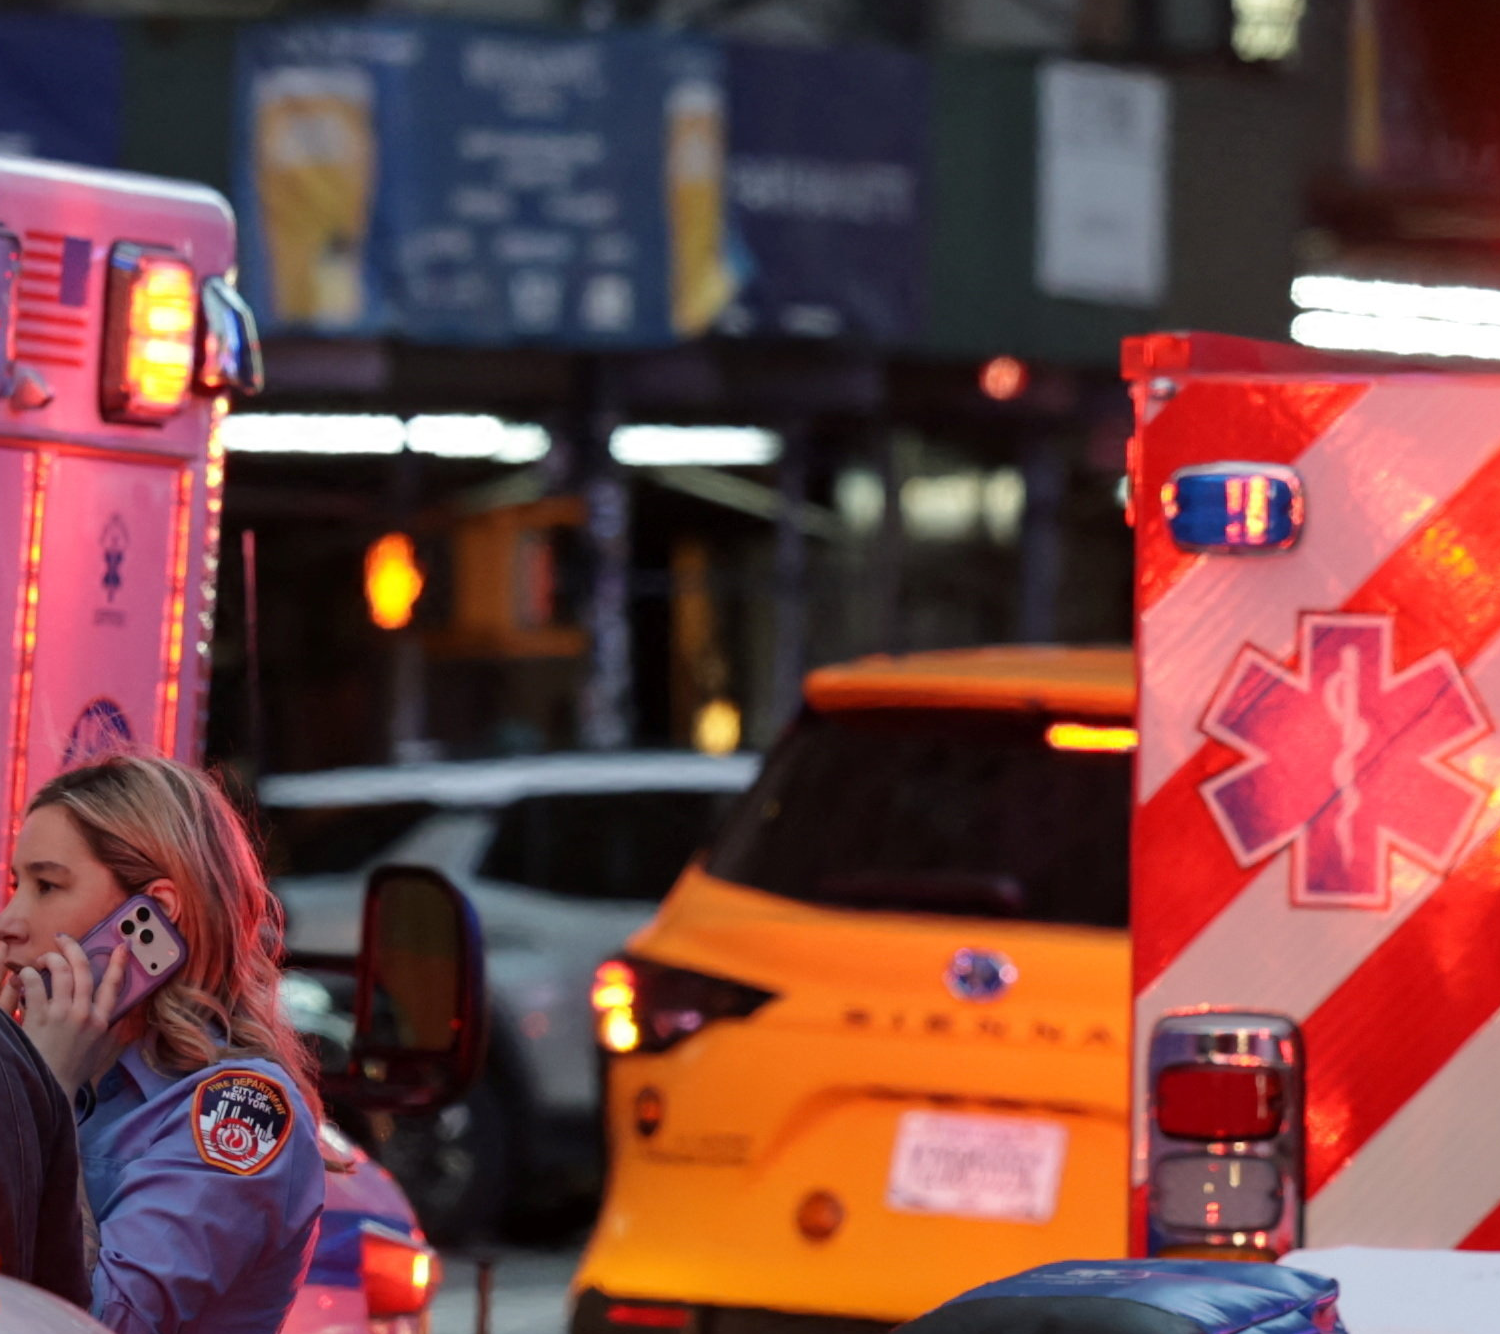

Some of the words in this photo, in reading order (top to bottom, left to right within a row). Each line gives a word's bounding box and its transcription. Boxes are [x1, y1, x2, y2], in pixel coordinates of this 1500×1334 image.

[208, 1079, 231, 1093] FIRE
[232, 1077, 286, 1116] DEPARTMENT
[221, 1090, 246, 1103] NEW
[248, 1097, 272, 1115] YORK
[231, 1085, 253, 1097] CITY
[256, 1092, 269, 1102] OF
